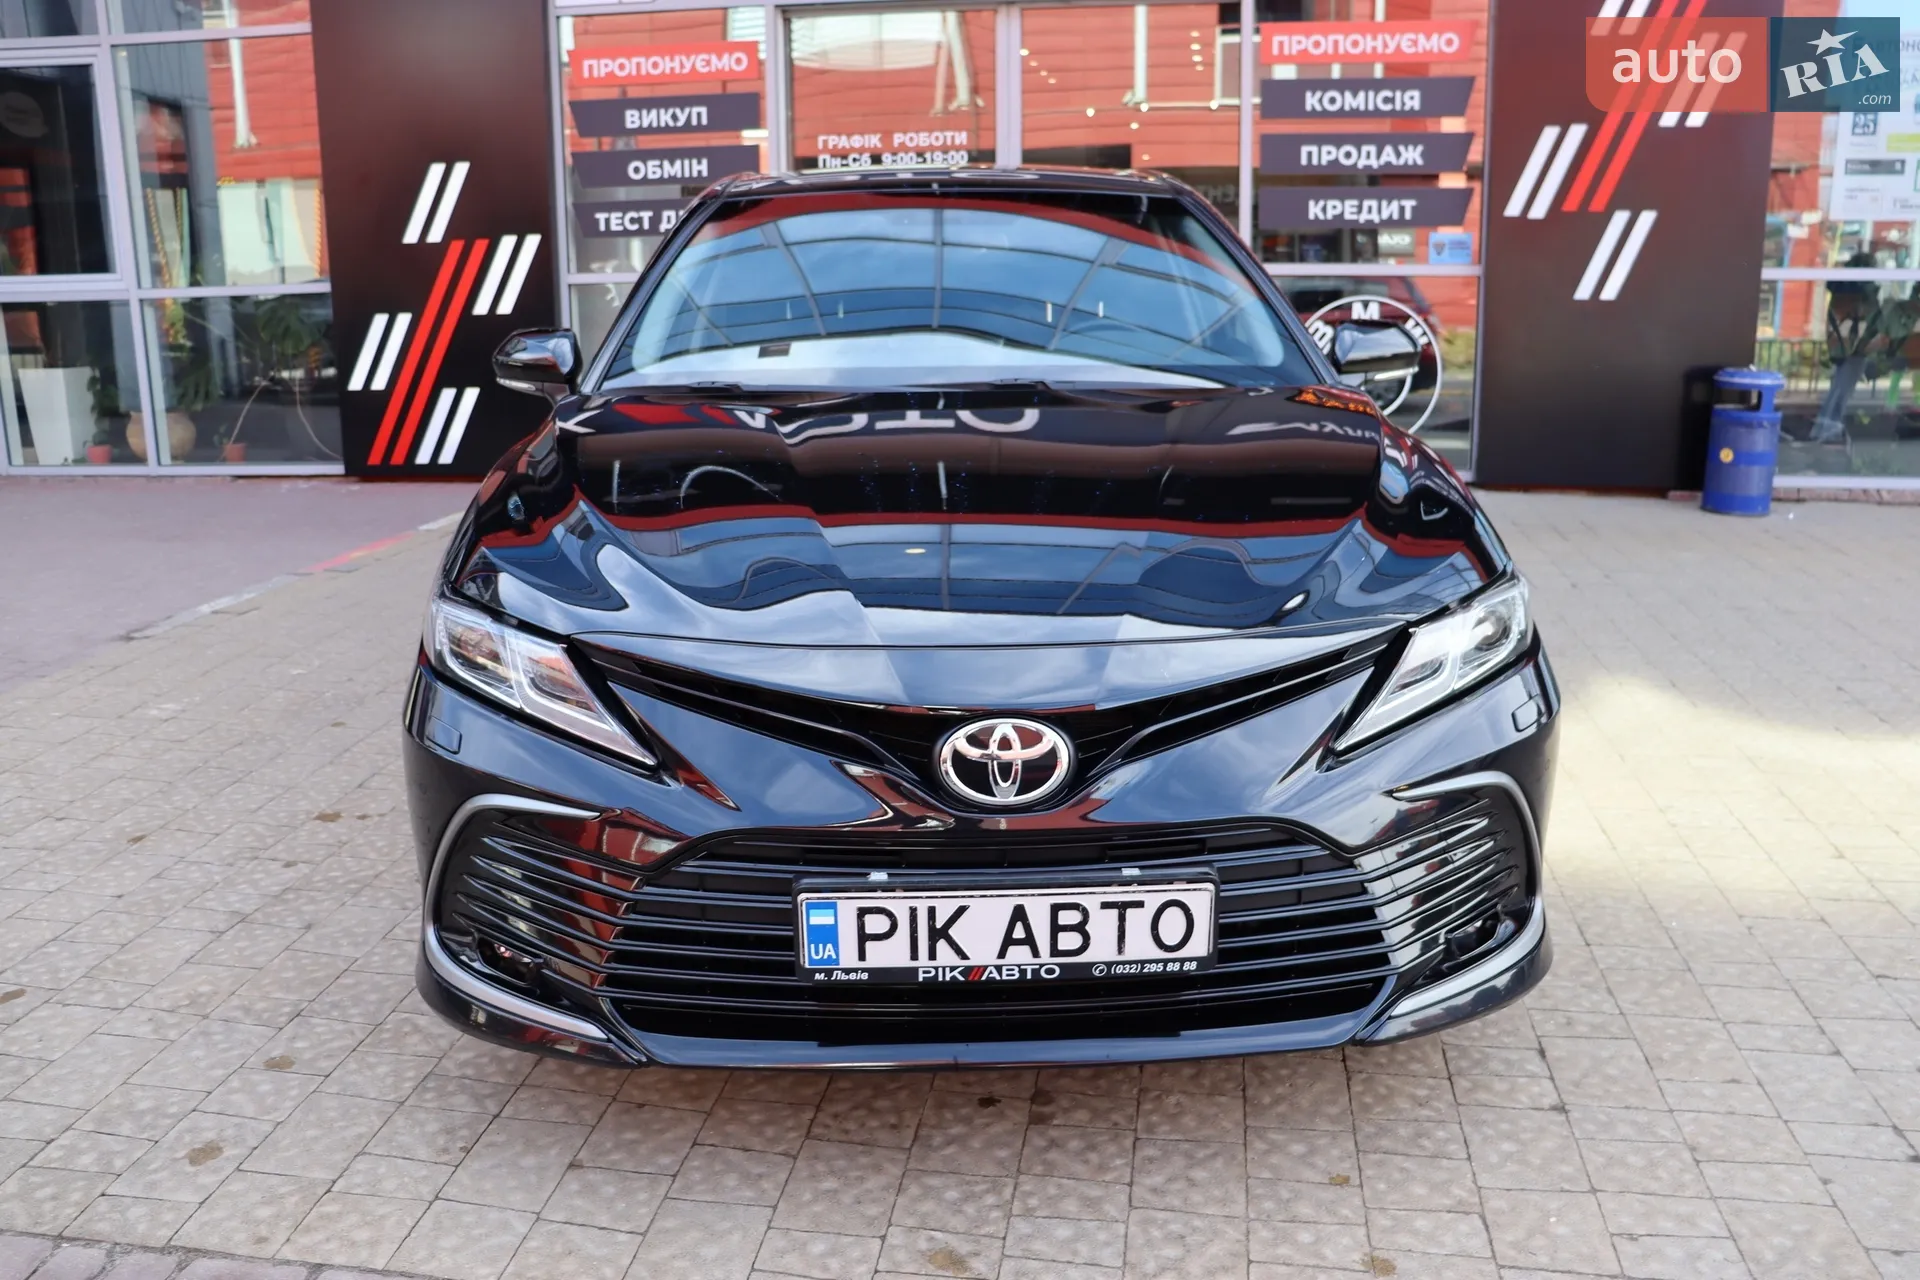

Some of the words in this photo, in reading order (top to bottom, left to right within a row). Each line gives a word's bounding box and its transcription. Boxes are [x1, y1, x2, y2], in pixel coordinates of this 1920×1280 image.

[1272, 32, 1460, 55] ПРОПОНУЄМО
[582, 52, 748, 78] ПРОПОНУЄМО
[1304, 90, 1421, 111] КОМІСІЯ
[624, 106, 708, 129] ВИКУП
[817, 134, 882, 150] ГРАФІК
[893, 131, 968, 148] РОБОТИ
[818, 153, 872, 168] Пн-Сб
[881, 150, 968, 166] 9:00-19:00
[1300, 144, 1424, 168] ПРОДАЖ
[627, 158, 708, 180] ОБМІН
[595, 210, 653, 231] ТЕСТ
[1308, 199, 1417, 223] КРЕДИТ
[810, 943, 837, 960] UA
[831, 970, 869, 980] Львів
[1111, 963, 1140, 974] (032)
[1143, 962, 1164, 973] 295
[1166, 962, 1180, 972] 88
[1182, 961, 1197, 971] 88
